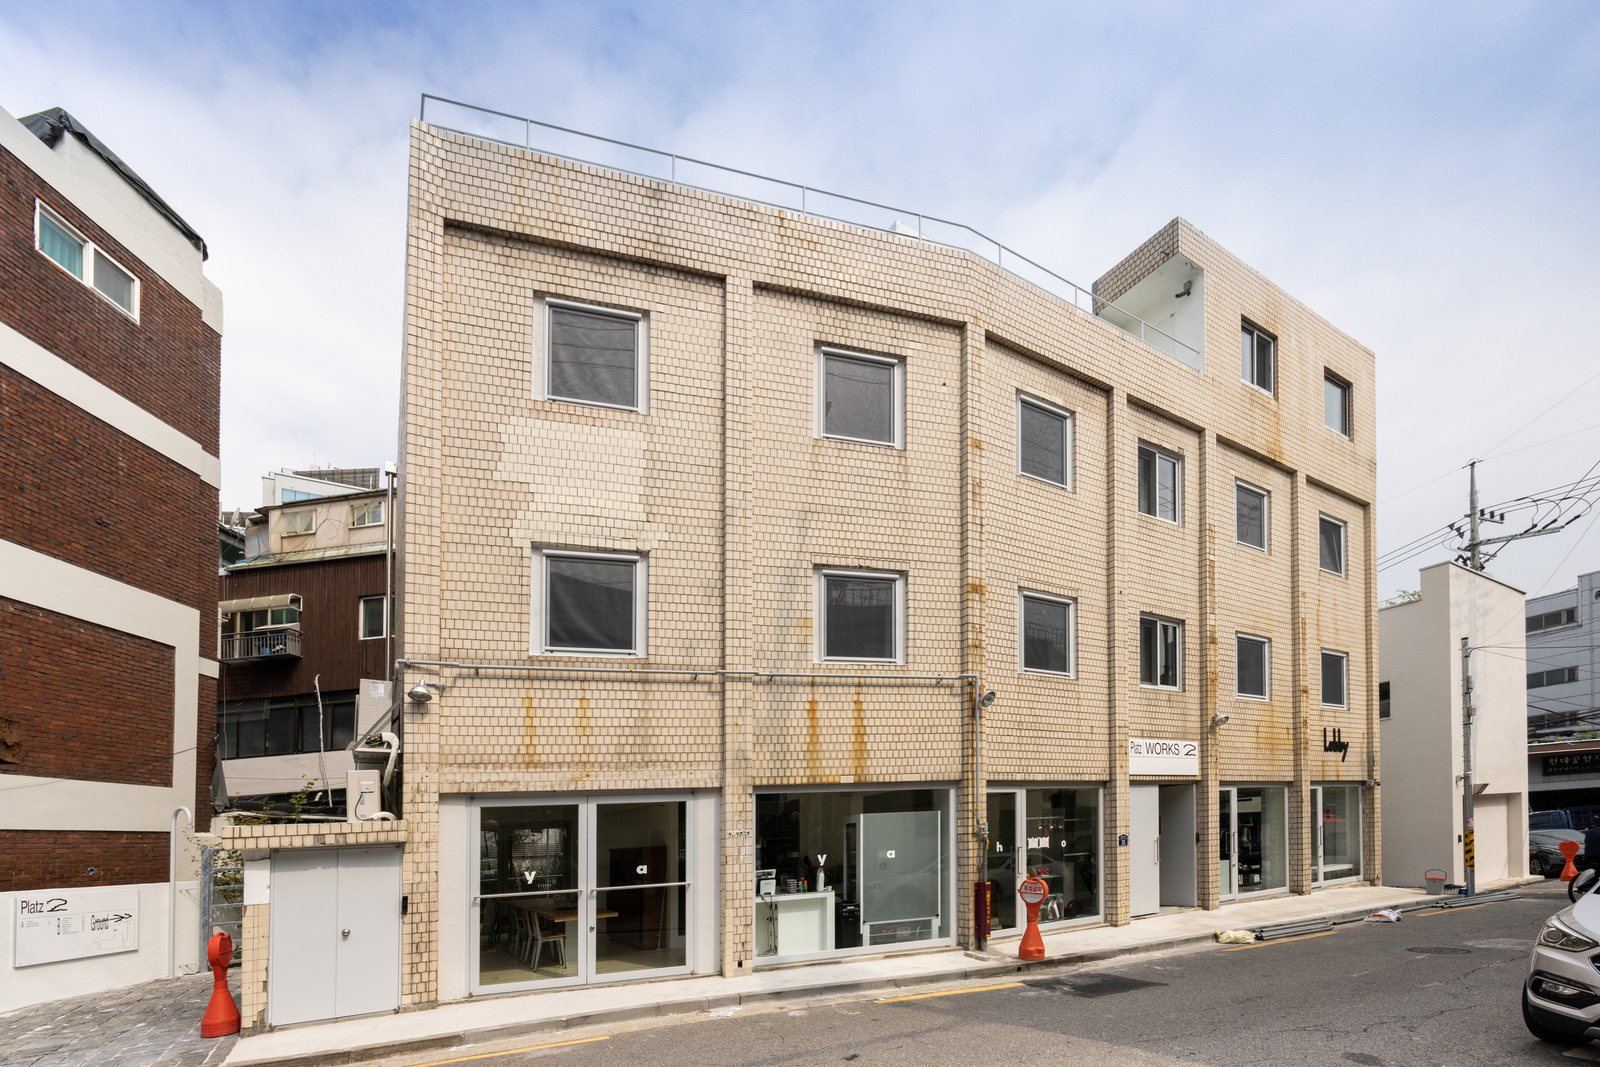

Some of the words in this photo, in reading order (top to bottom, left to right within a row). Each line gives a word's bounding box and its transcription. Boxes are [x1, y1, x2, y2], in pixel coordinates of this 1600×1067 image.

[1130, 740, 1142, 755] Platz
[1145, 742, 1180, 756] WORKS
[1183, 743, 1197, 757] 2
[21, 900, 44, 914] Platz
[46, 898, 68, 912] 2
